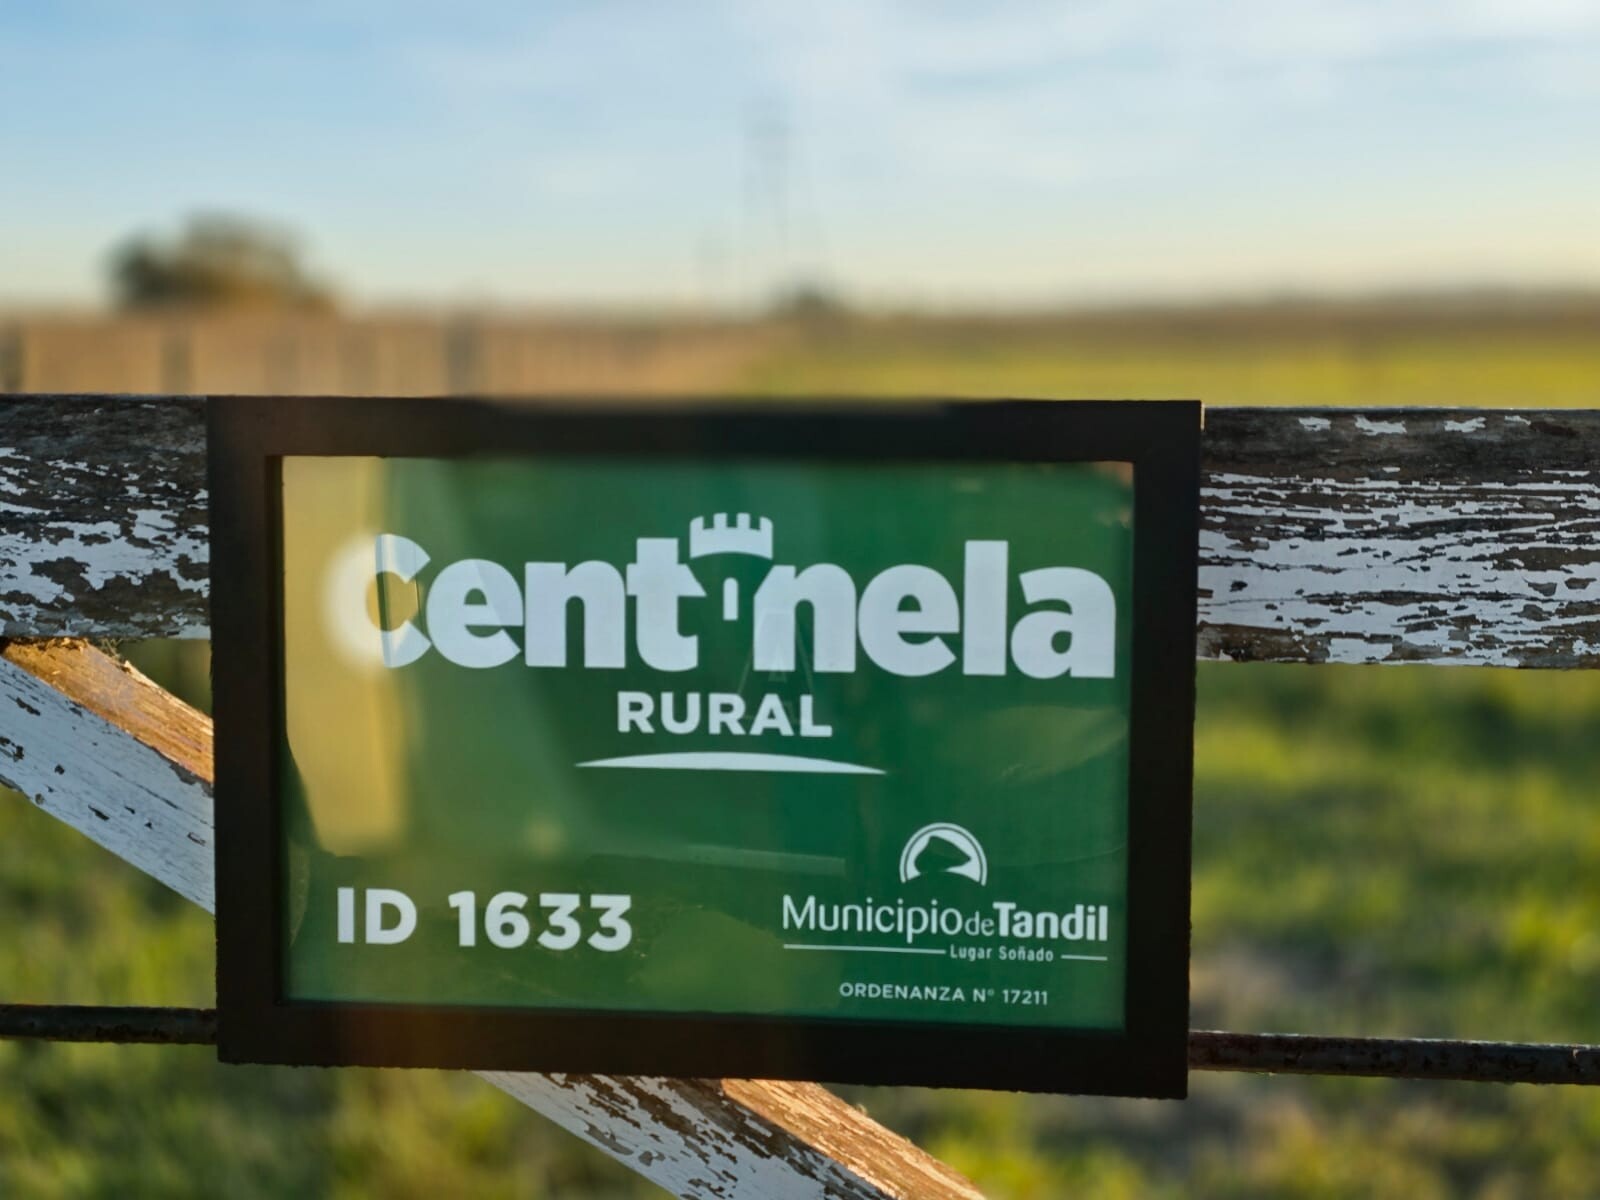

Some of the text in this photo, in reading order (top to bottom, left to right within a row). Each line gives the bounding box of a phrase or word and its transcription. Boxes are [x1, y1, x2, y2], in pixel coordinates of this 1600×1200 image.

[617, 691, 833, 738] RURAL
[337, 887, 633, 952] ID 1633
[950, 944, 1054, 962] Lugar Soñado
[839, 982, 966, 1002] ORDENANZA
[1003, 989, 1049, 1006] 17211
